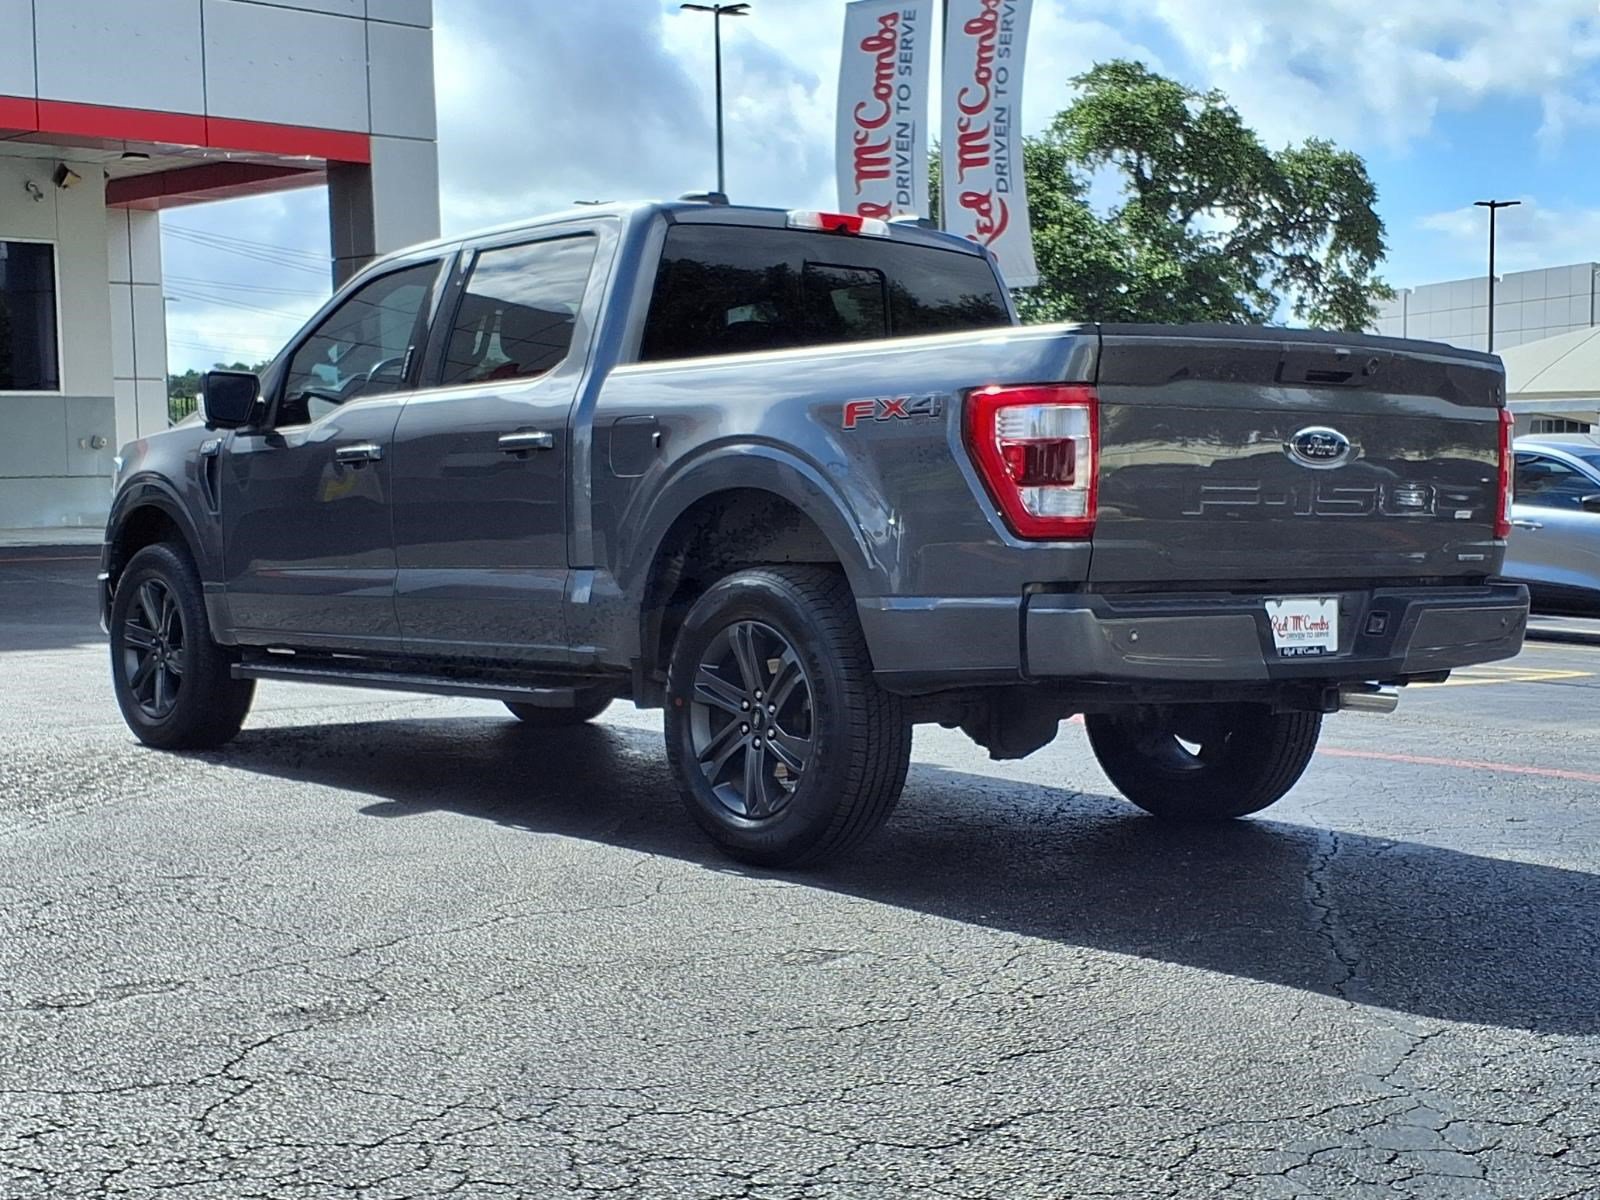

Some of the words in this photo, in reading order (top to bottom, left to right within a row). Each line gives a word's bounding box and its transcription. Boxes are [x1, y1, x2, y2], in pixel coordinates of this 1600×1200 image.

[898, 9, 917, 76] SERVE
[997, 0, 1018, 58] SERV
[854, 12, 899, 195] McCombs
[896, 84, 911, 114] TO
[957, 0, 1000, 184] McCombs
[995, 66, 1009, 98] TO
[896, 123, 911, 207] DRIVEN
[994, 106, 1010, 194] DRIVEN
[840, 392, 944, 431] FX4
[1306, 434, 1339, 455] Ford
[1271, 614, 1289, 637] Red
[1290, 615, 1329, 632] McCombs
